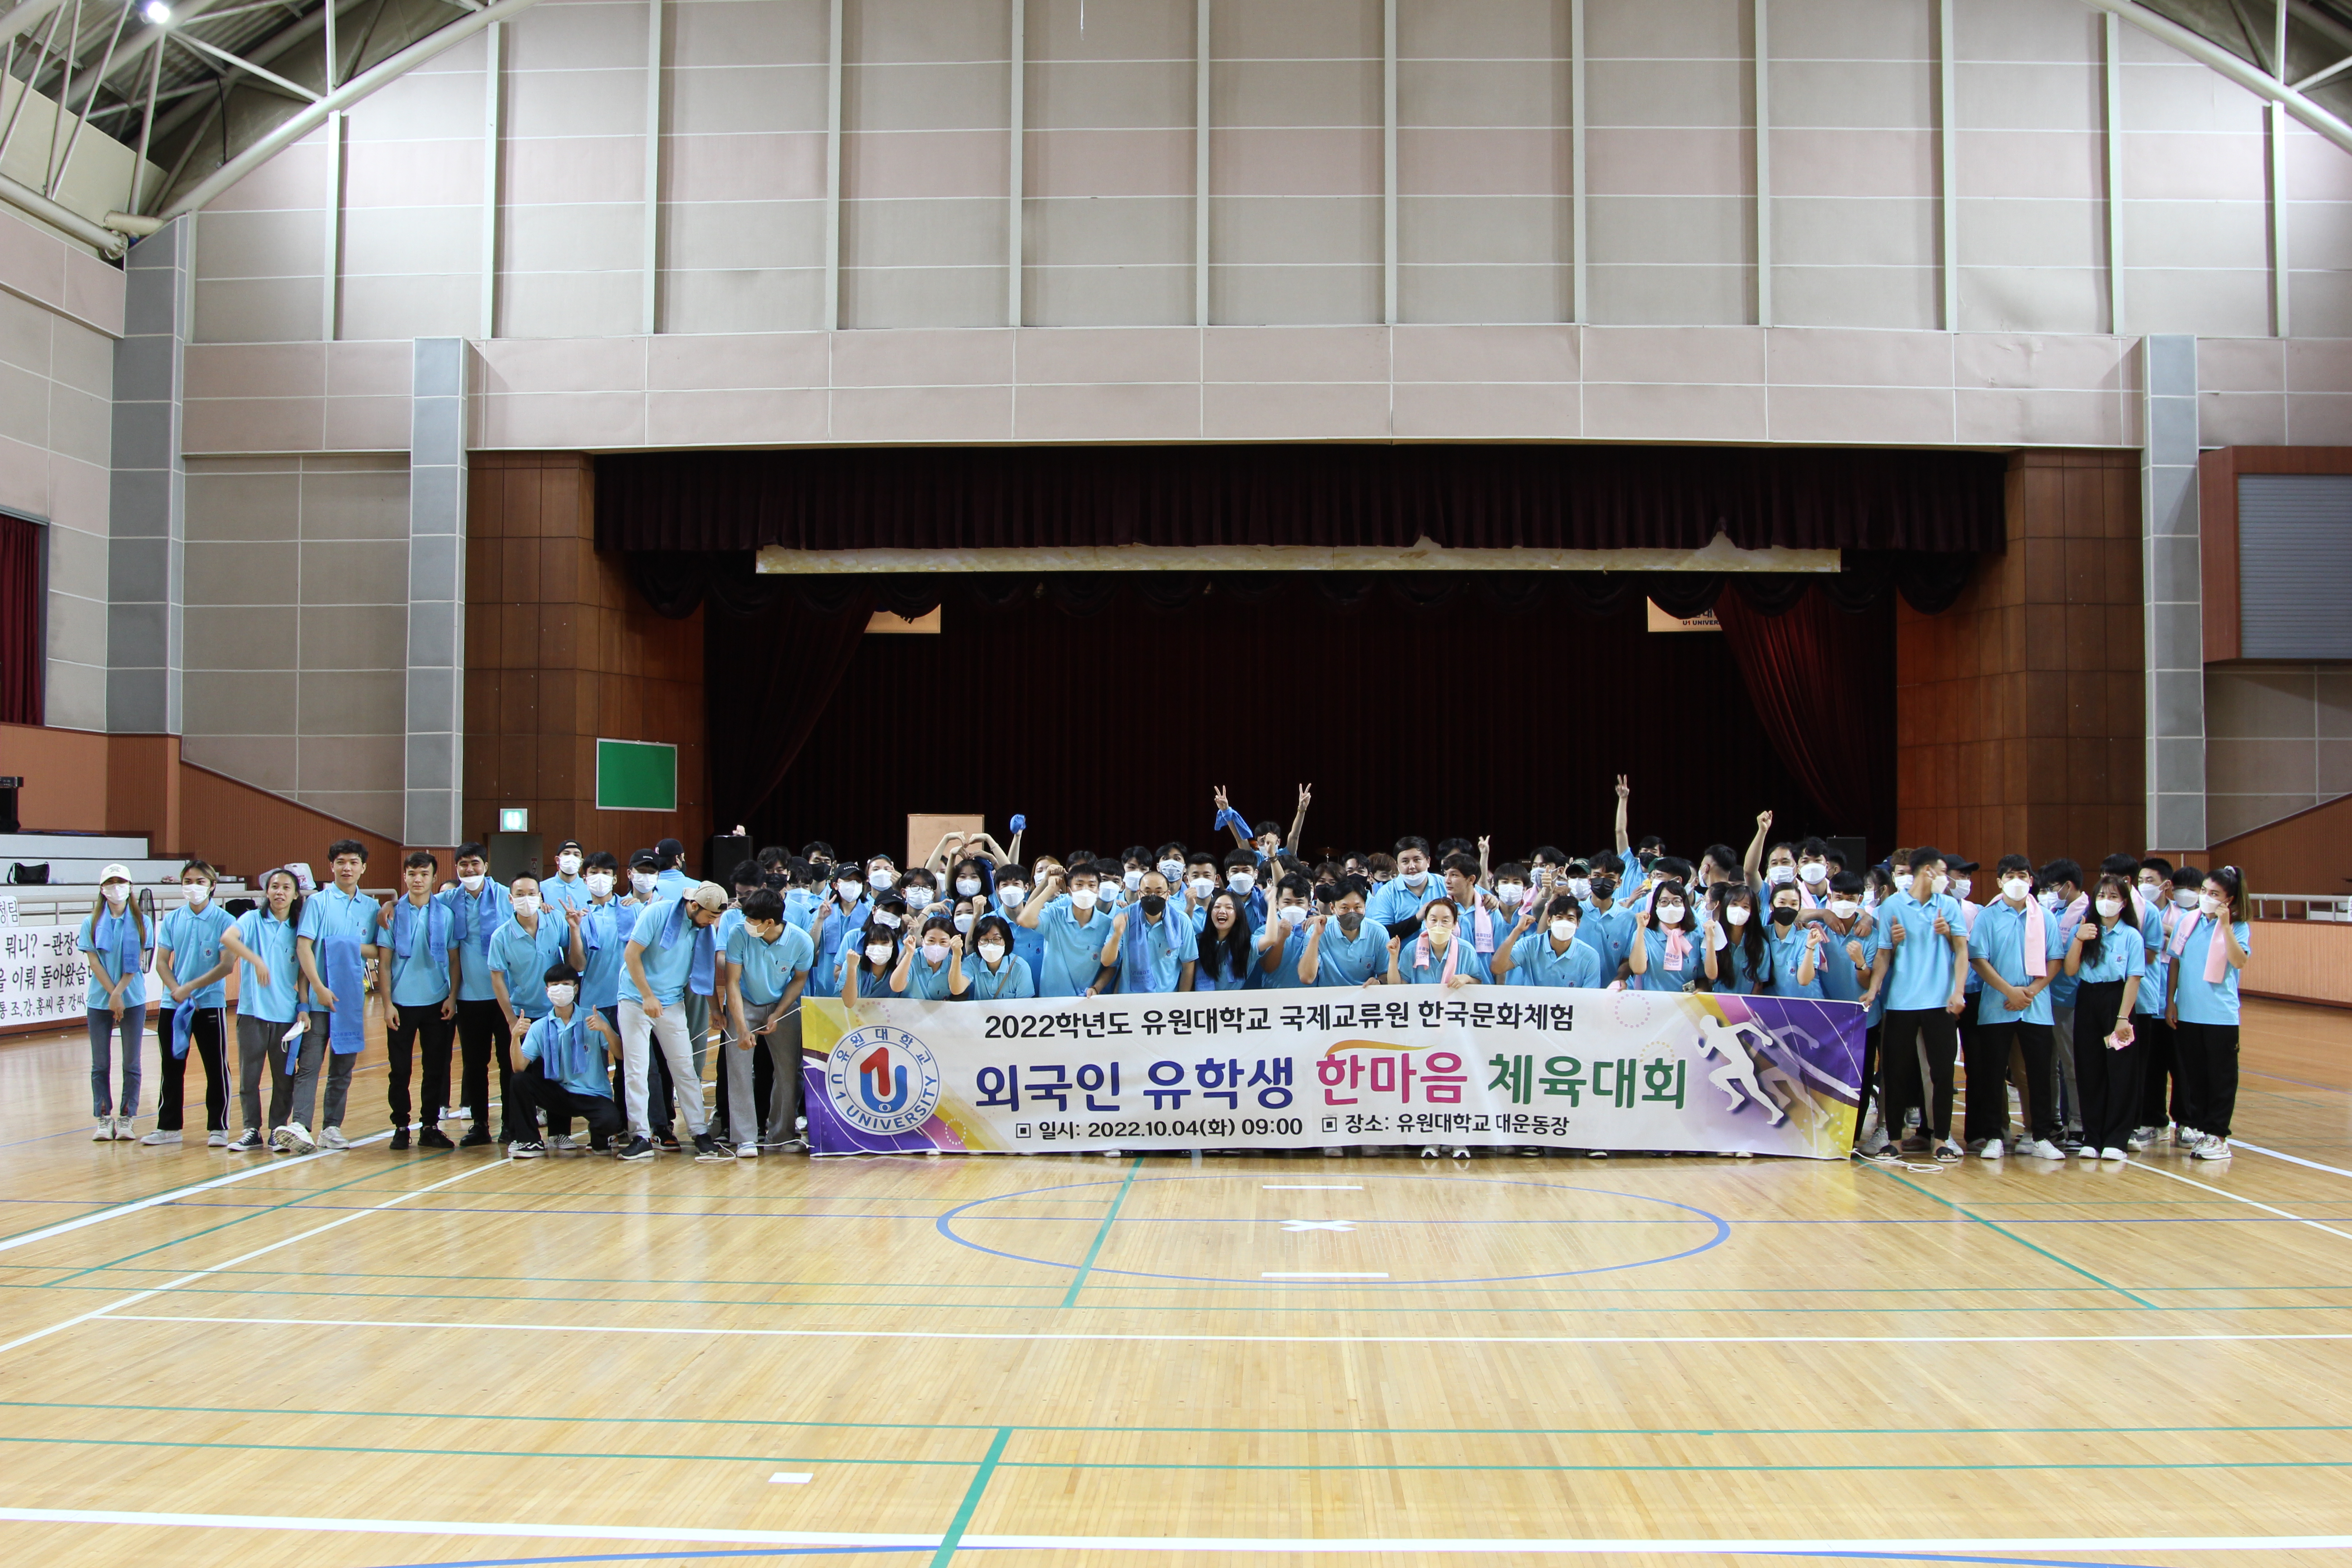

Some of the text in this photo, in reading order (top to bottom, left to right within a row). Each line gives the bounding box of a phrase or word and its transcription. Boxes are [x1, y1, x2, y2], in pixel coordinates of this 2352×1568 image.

[5, 934, 37, 960] 뭐니?
[12, 966, 36, 992] 이뤄
[57, 996, 65, 1013] 중
[985, 1000, 1573, 1039] 2022학년도 유원대학교 국제교류원 한국문화체험
[836, 1028, 931, 1065] 유원대학교
[976, 1052, 1686, 1112] 외국인 유학생 한마음 체육대회
[846, 1075, 937, 1130] UNIVERSITY
[1039, 1113, 1570, 1140] 일시: 2022.10.04(화) 09:00 장소: 유원대학교 대운동장
